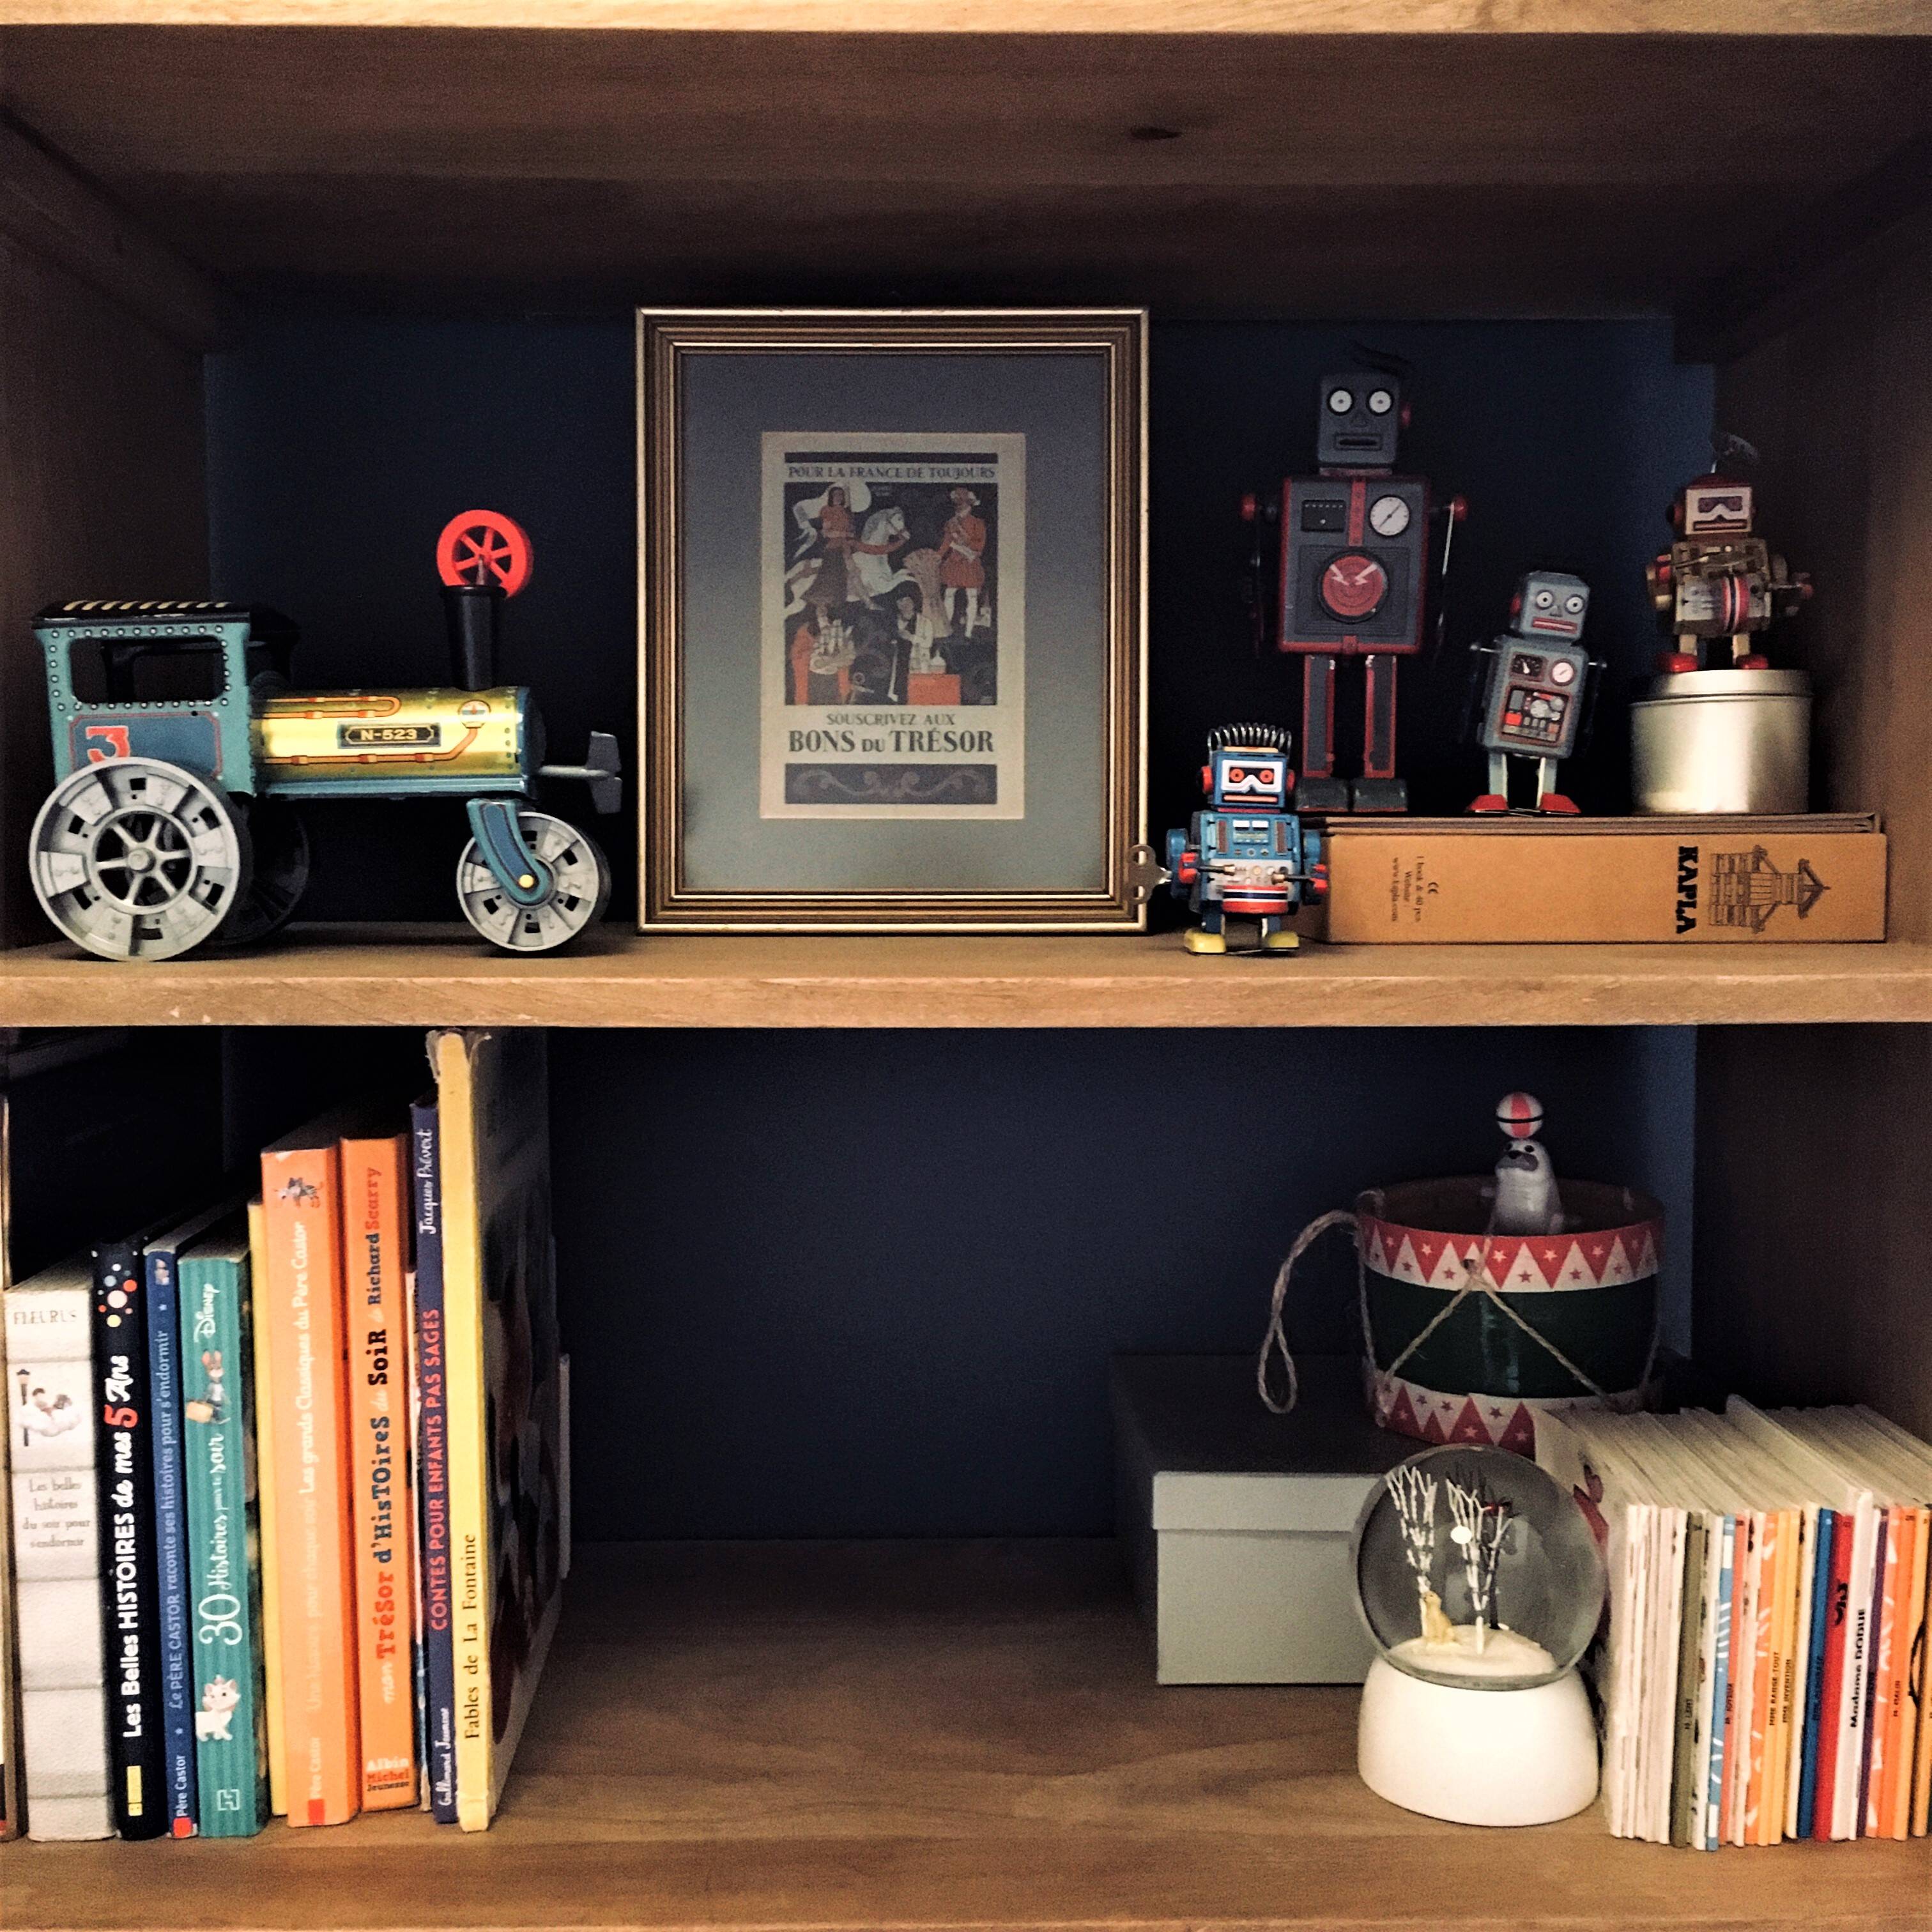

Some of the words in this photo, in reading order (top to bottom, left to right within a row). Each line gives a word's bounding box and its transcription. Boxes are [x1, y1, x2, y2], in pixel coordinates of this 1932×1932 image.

[789, 466, 824, 477] POUR
[828, 466, 845, 477] LA
[850, 466, 901, 478] FRANCE
[906, 467, 926, 478] DE
[930, 467, 995, 479] TOUJOURS
[360, 728, 417, 741] N-523
[788, 729, 855, 753] BONS
[862, 739, 885, 753] DU
[890, 727, 994, 753] TRÉSOR
[826, 713, 917, 726] SOUSCRIVEZ
[921, 713, 956, 725] AUX
[85, 725, 130, 763] 3
[1675, 846, 1698, 934] KAPLA
[417, 1128, 433, 1179] Prévert
[364, 1167, 382, 1230] Scarry
[418, 1181, 440, 1235] Jacques
[290, 1221, 308, 1270] Castor
[291, 1272, 309, 1308] Père
[365, 1233, 381, 1305] Richard
[13, 1310, 77, 1324] FLEURUS
[293, 1310, 310, 1330] du
[422, 1308, 441, 1367] SAGES
[104, 1355, 134, 1402] Ans
[154, 1330, 172, 1409] s'endormir
[295, 1332, 316, 1411] Classiques
[425, 1373, 441, 1408] PAS
[103, 1404, 139, 1429] 5
[161, 1416, 177, 1446] pour
[114, 1432, 134, 1474] mes
[208, 1433, 227, 1475] soir
[296, 1412, 319, 1465] grands
[426, 1414, 444, 1494] ENFANTS
[29, 1477, 47, 1492] Les
[52, 1477, 82, 1491] belles
[111, 1480, 134, 1508] de
[160, 1448, 176, 1510] histoires
[299, 1466, 316, 1495] Les
[22, 1517, 37, 1529] du
[66, 1519, 91, 1531] pour
[162, 1512, 176, 1533] ses
[429, 1499, 445, 1550] POUR
[114, 1512, 139, 1629] HISTOIRES
[163, 1535, 178, 1590] raconte
[206, 1514, 232, 1590] Histoires
[460, 1533, 477, 1611] Fontaine
[429, 1556, 448, 1631] CONTES
[167, 1593, 182, 1650] CASTOR
[198, 1593, 243, 1646] 30
[463, 1623, 478, 1643] La
[1855, 1609, 1866, 1660] DODUE
[120, 1634, 140, 1696] Belles
[167, 1653, 184, 1694] PÈRE
[463, 1654, 479, 1675] de
[168, 1695, 183, 1709] Le
[464, 1685, 480, 1740] Fables
[1850, 1664, 1862, 1728] Madame
[122, 1703, 142, 1737] Les
[434, 1707, 451, 1749] Jeunesse
[174, 1755, 187, 1794] Castor
[367, 1756, 409, 1772] Albin
[367, 1768, 410, 1783] Michel
[435, 1752, 452, 1806] Gallimard
[176, 1795, 188, 1817] Père
